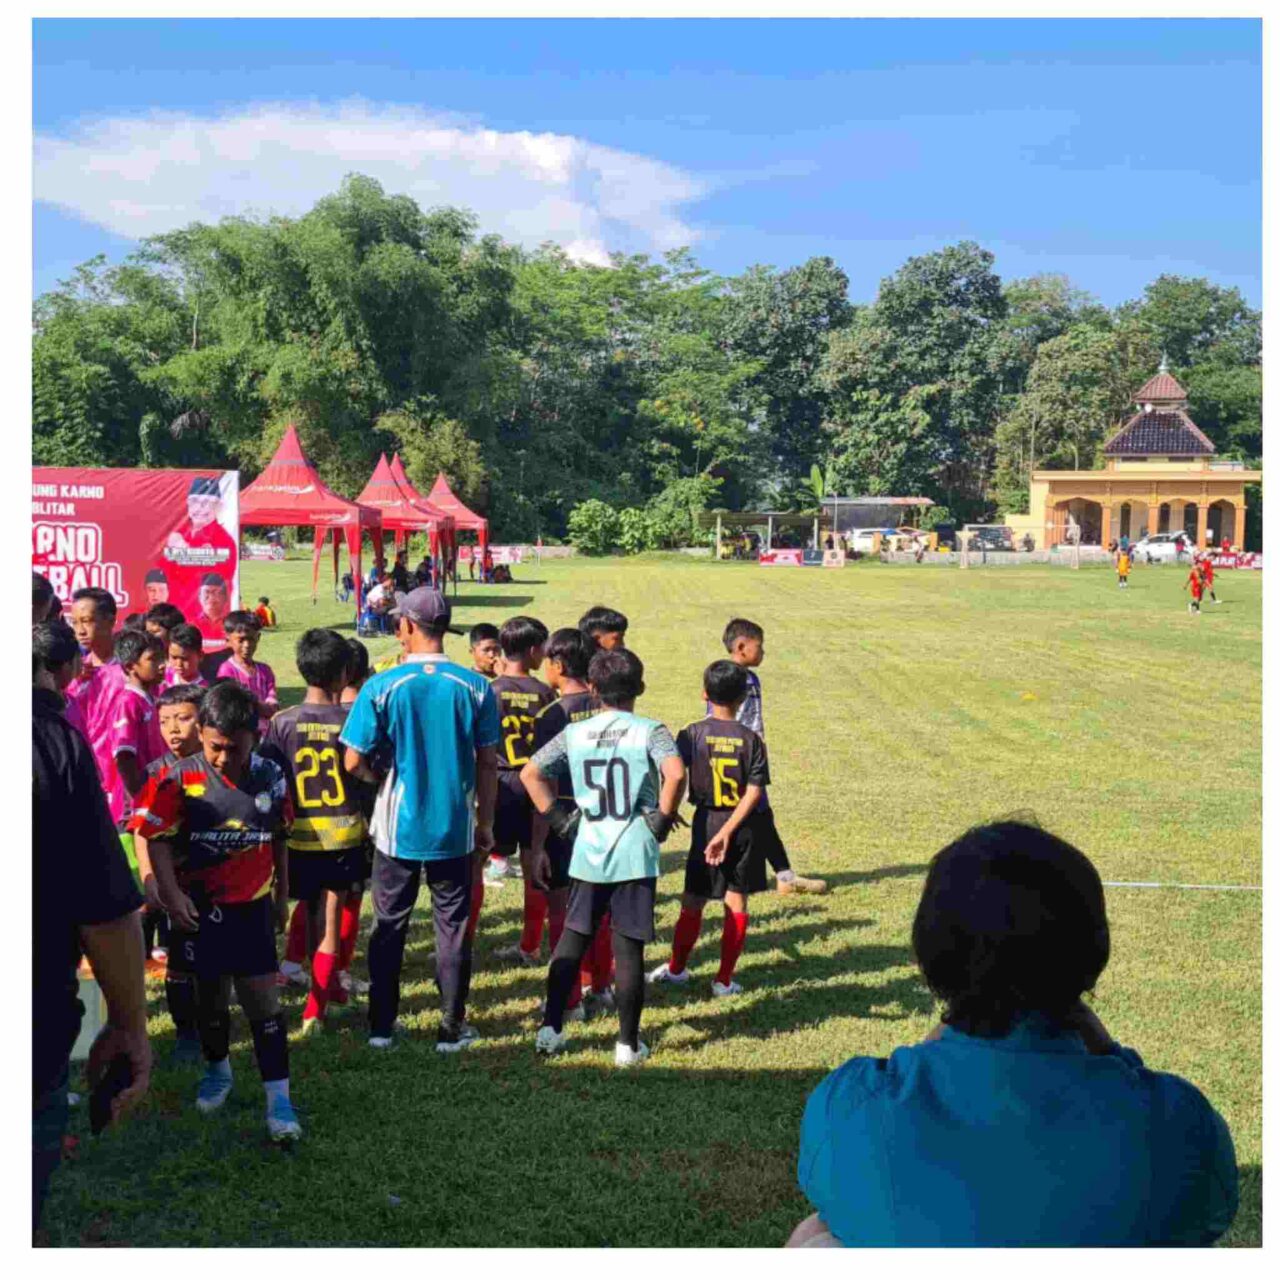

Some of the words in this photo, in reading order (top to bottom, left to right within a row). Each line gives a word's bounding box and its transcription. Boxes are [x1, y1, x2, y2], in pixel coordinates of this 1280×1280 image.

[32, 484, 57, 498] UNG
[60, 484, 105, 500] KARNO
[295, 746, 346, 808] 23
[583, 757, 631, 822] 50
[709, 757, 740, 808] 15
